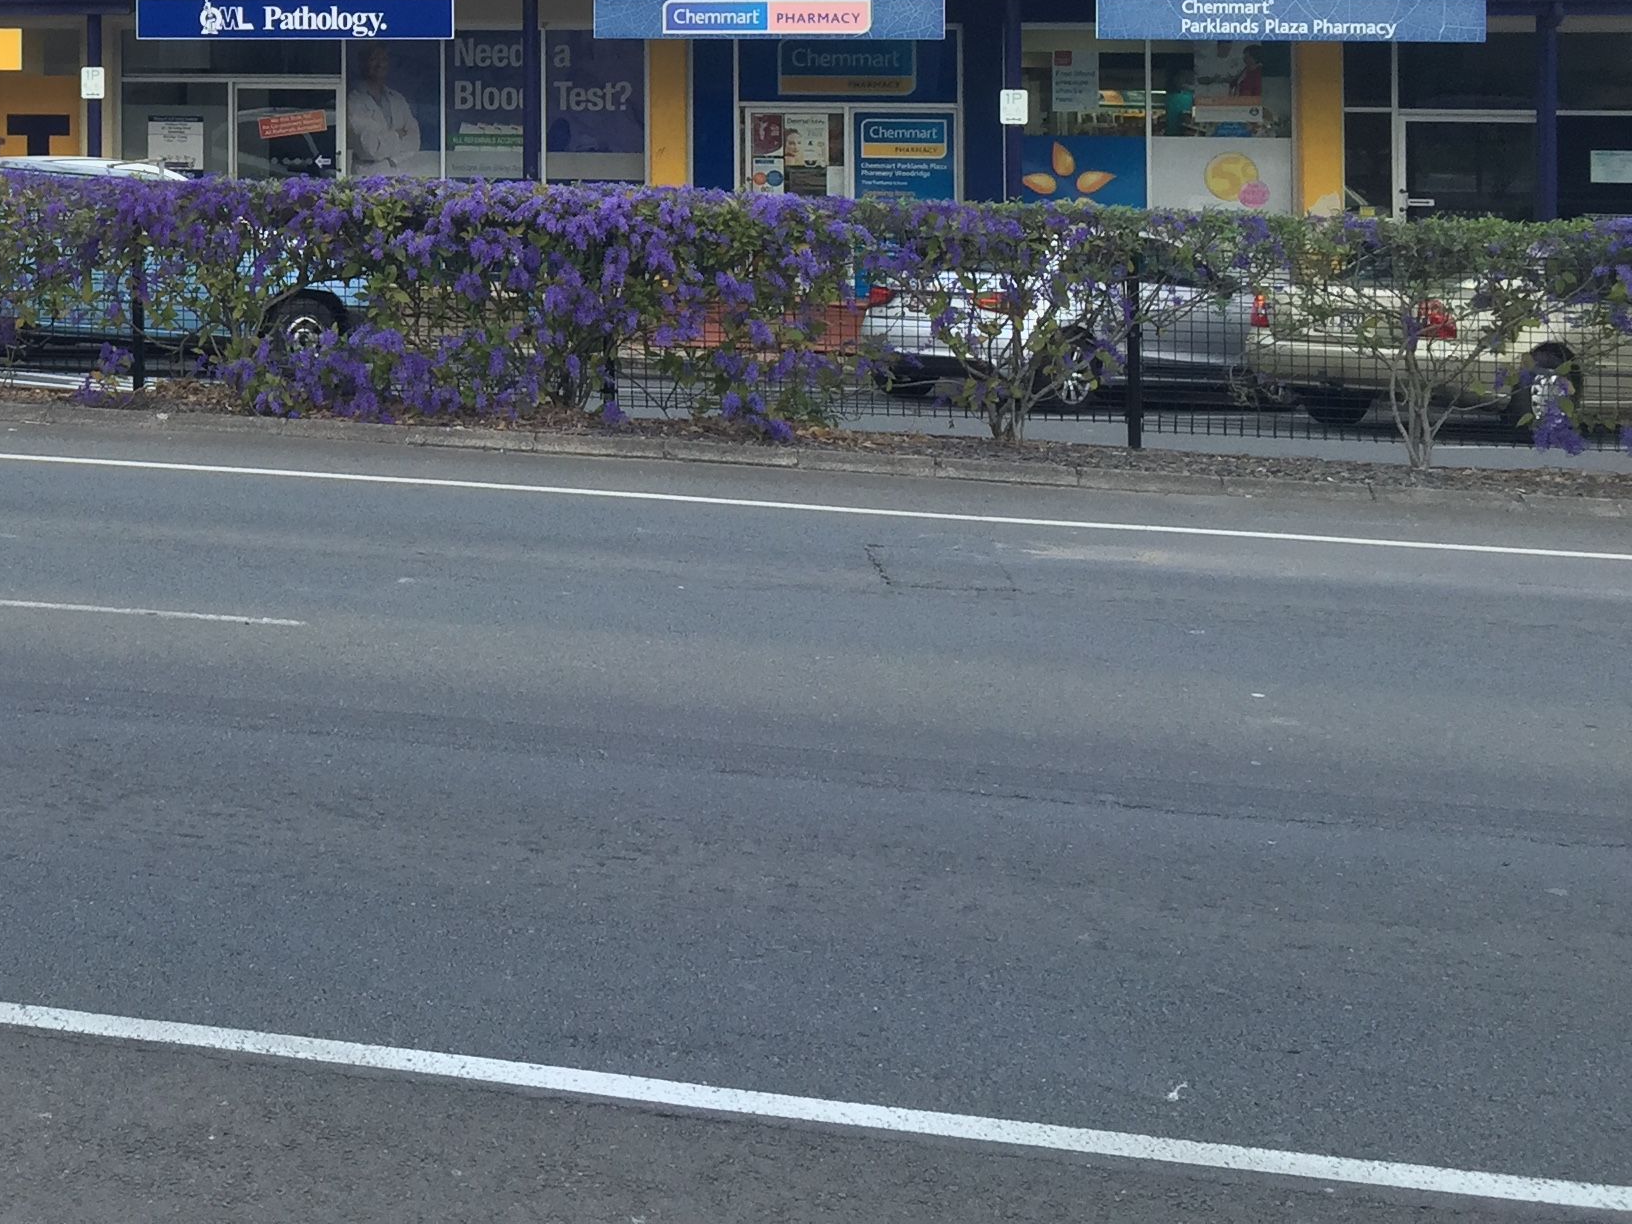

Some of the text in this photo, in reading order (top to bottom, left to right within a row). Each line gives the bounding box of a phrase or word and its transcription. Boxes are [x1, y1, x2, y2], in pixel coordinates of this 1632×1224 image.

[263, 5, 388, 36] Pathology.
[776, 12, 861, 24] PHARMACY
[1181, 18, 1398, 40] Parklands Plaza Pharmacy
[454, 38, 524, 69] Need
[791, 48, 900, 68] Chemmart
[454, 80, 633, 112] Bloo Test?
[870, 125, 938, 139] Chemmart
